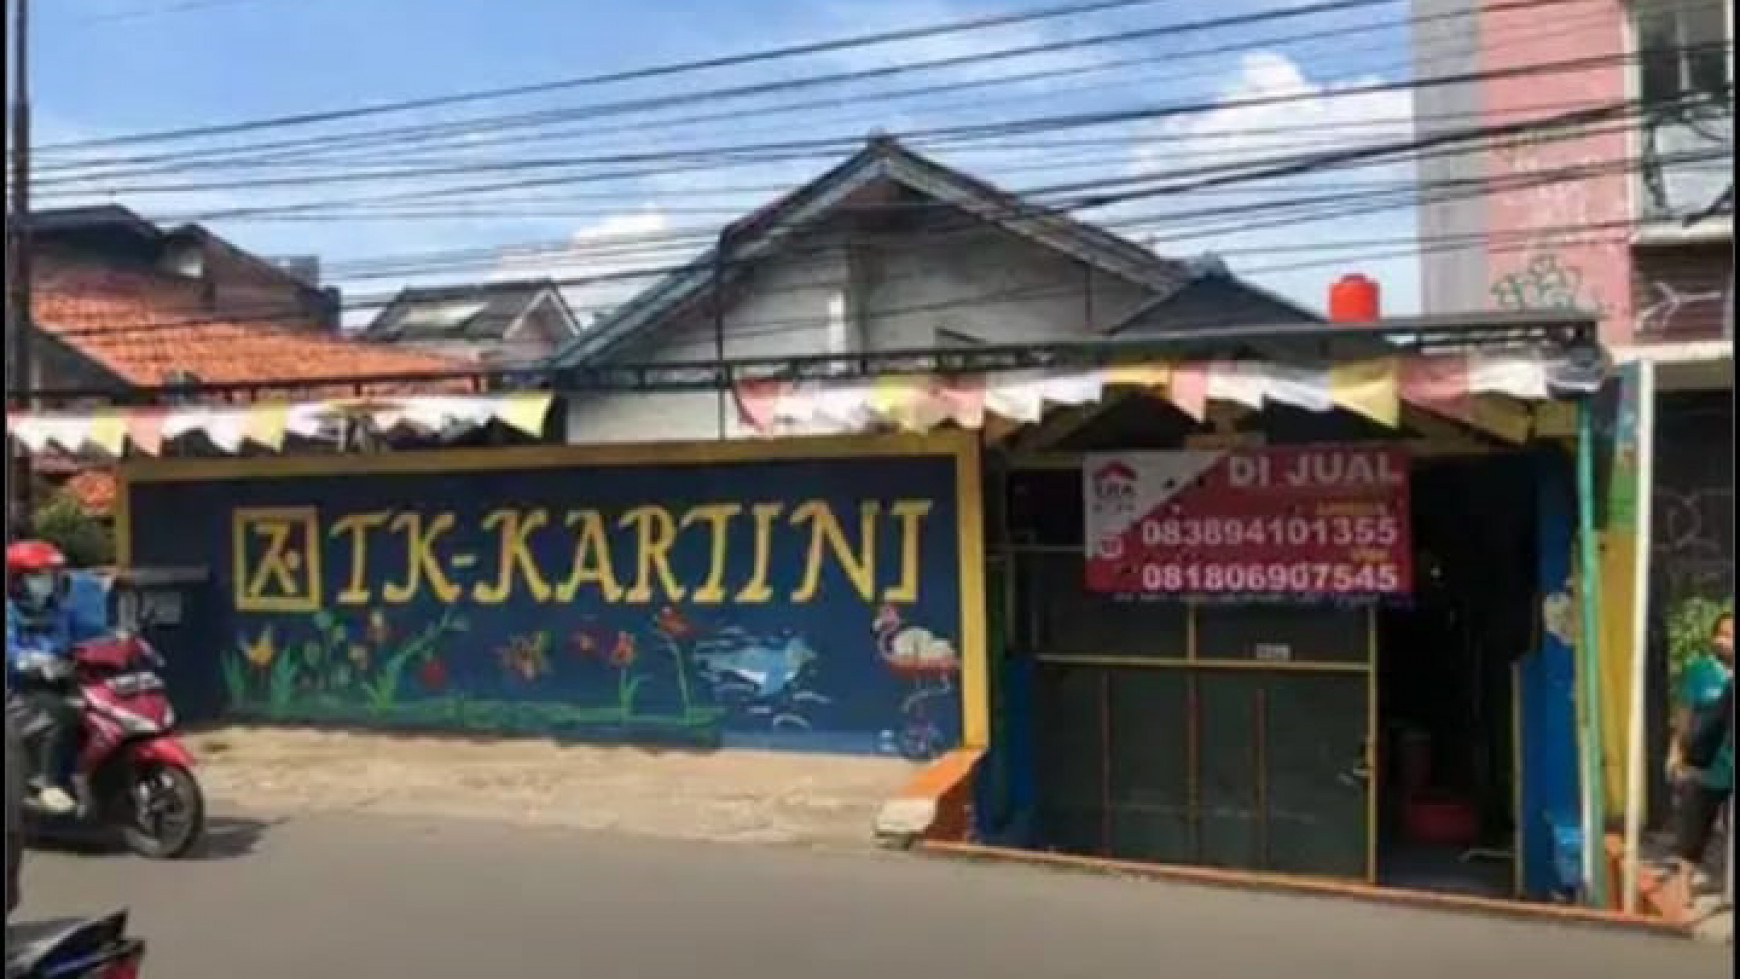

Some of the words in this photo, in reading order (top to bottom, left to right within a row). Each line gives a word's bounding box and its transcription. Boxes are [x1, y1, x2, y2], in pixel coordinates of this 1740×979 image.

[1230, 454, 1269, 486] DI
[1284, 452, 1403, 485] JUAL
[1142, 516, 1398, 545] 083894101355
[1142, 563, 1398, 591] 081806907545
